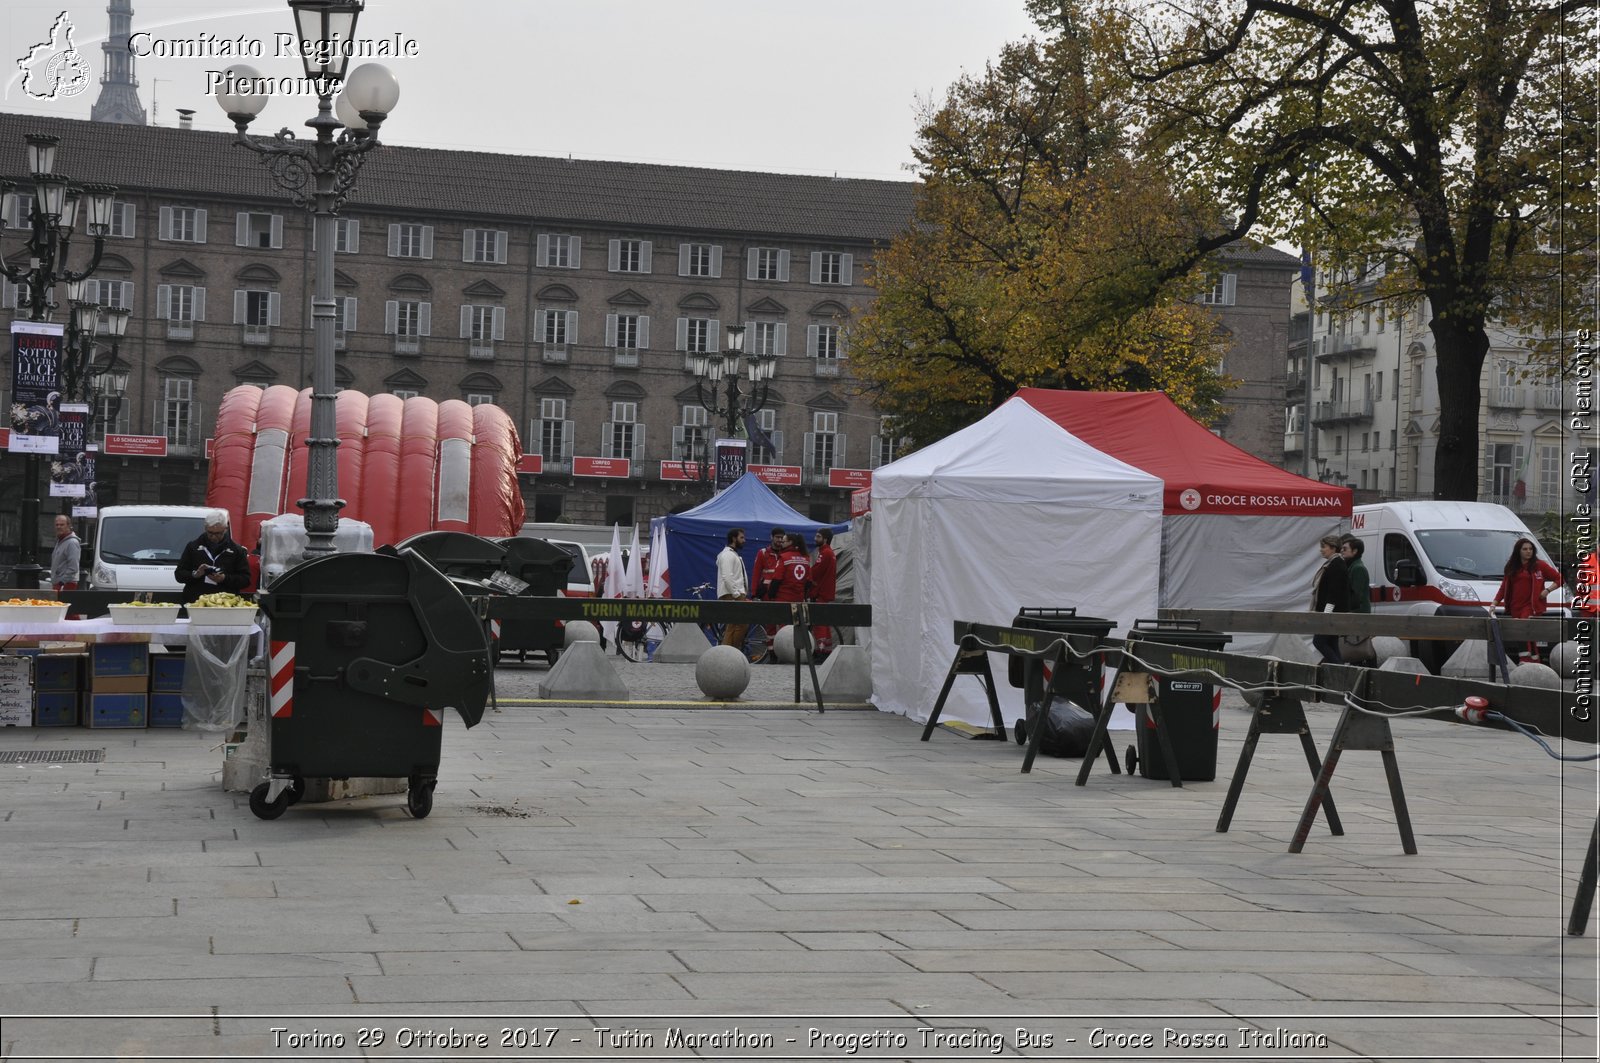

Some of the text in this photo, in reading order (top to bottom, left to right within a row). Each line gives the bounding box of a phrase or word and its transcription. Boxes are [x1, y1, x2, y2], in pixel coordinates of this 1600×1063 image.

[18, 348, 58, 358] SOTTO
[18, 362, 57, 376] LUCE
[1206, 495, 1342, 507] CROCE ROSSA ITALIANA
[582, 604, 699, 618] TURIN MARATHON
